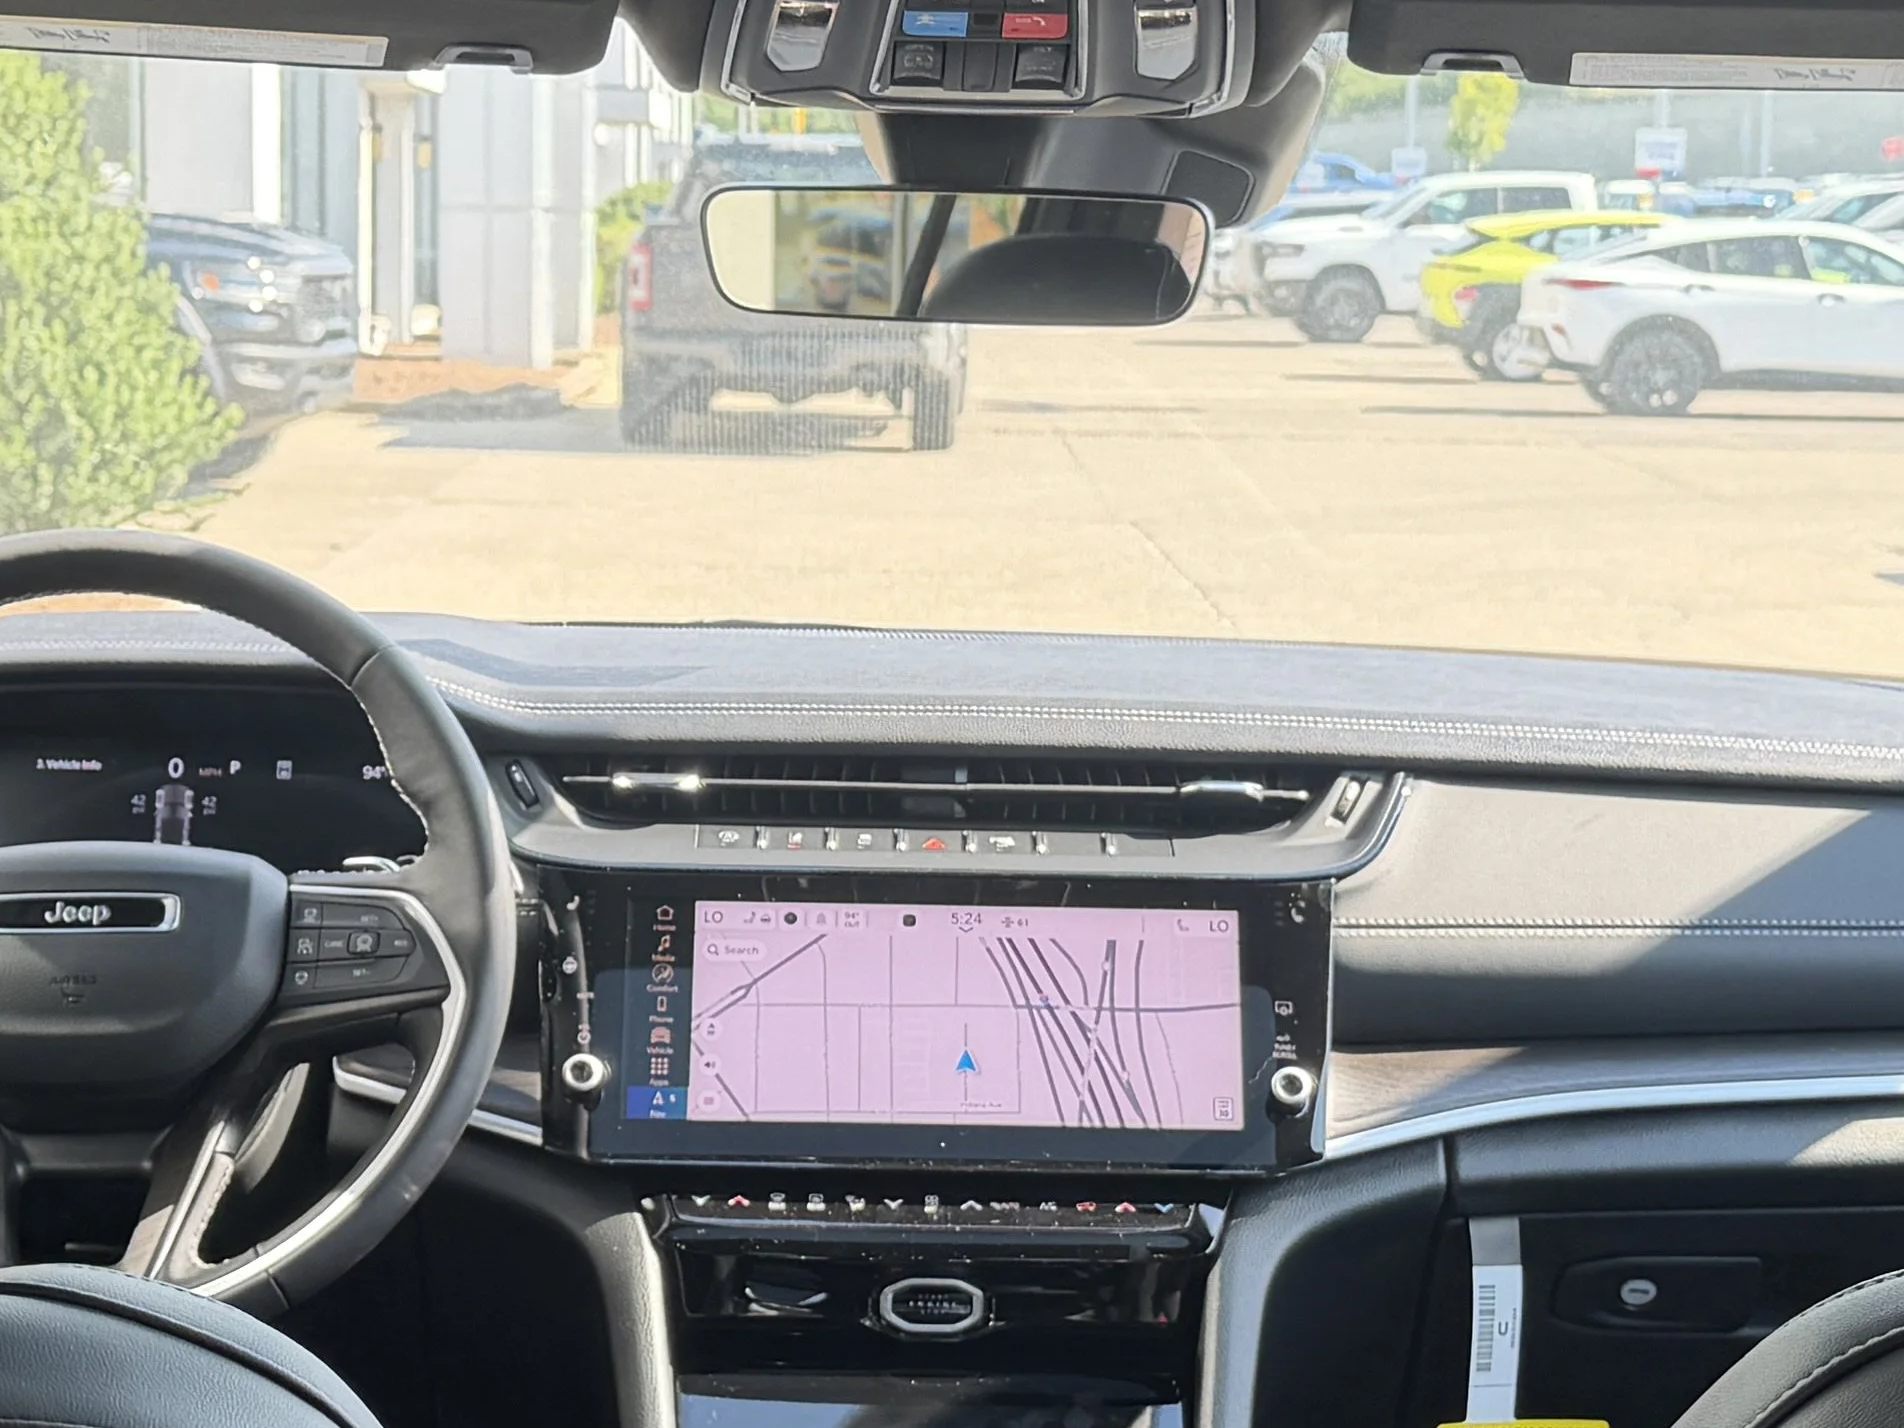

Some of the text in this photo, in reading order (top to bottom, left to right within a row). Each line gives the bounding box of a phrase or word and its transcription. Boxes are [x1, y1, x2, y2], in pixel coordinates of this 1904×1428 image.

[230, 760, 241, 775] P
[44, 901, 112, 926] Jeep
[704, 910, 724, 924] LO
[951, 912, 982, 925] 5:24
[1209, 920, 1229, 933] LO
[724, 945, 760, 956] Search
